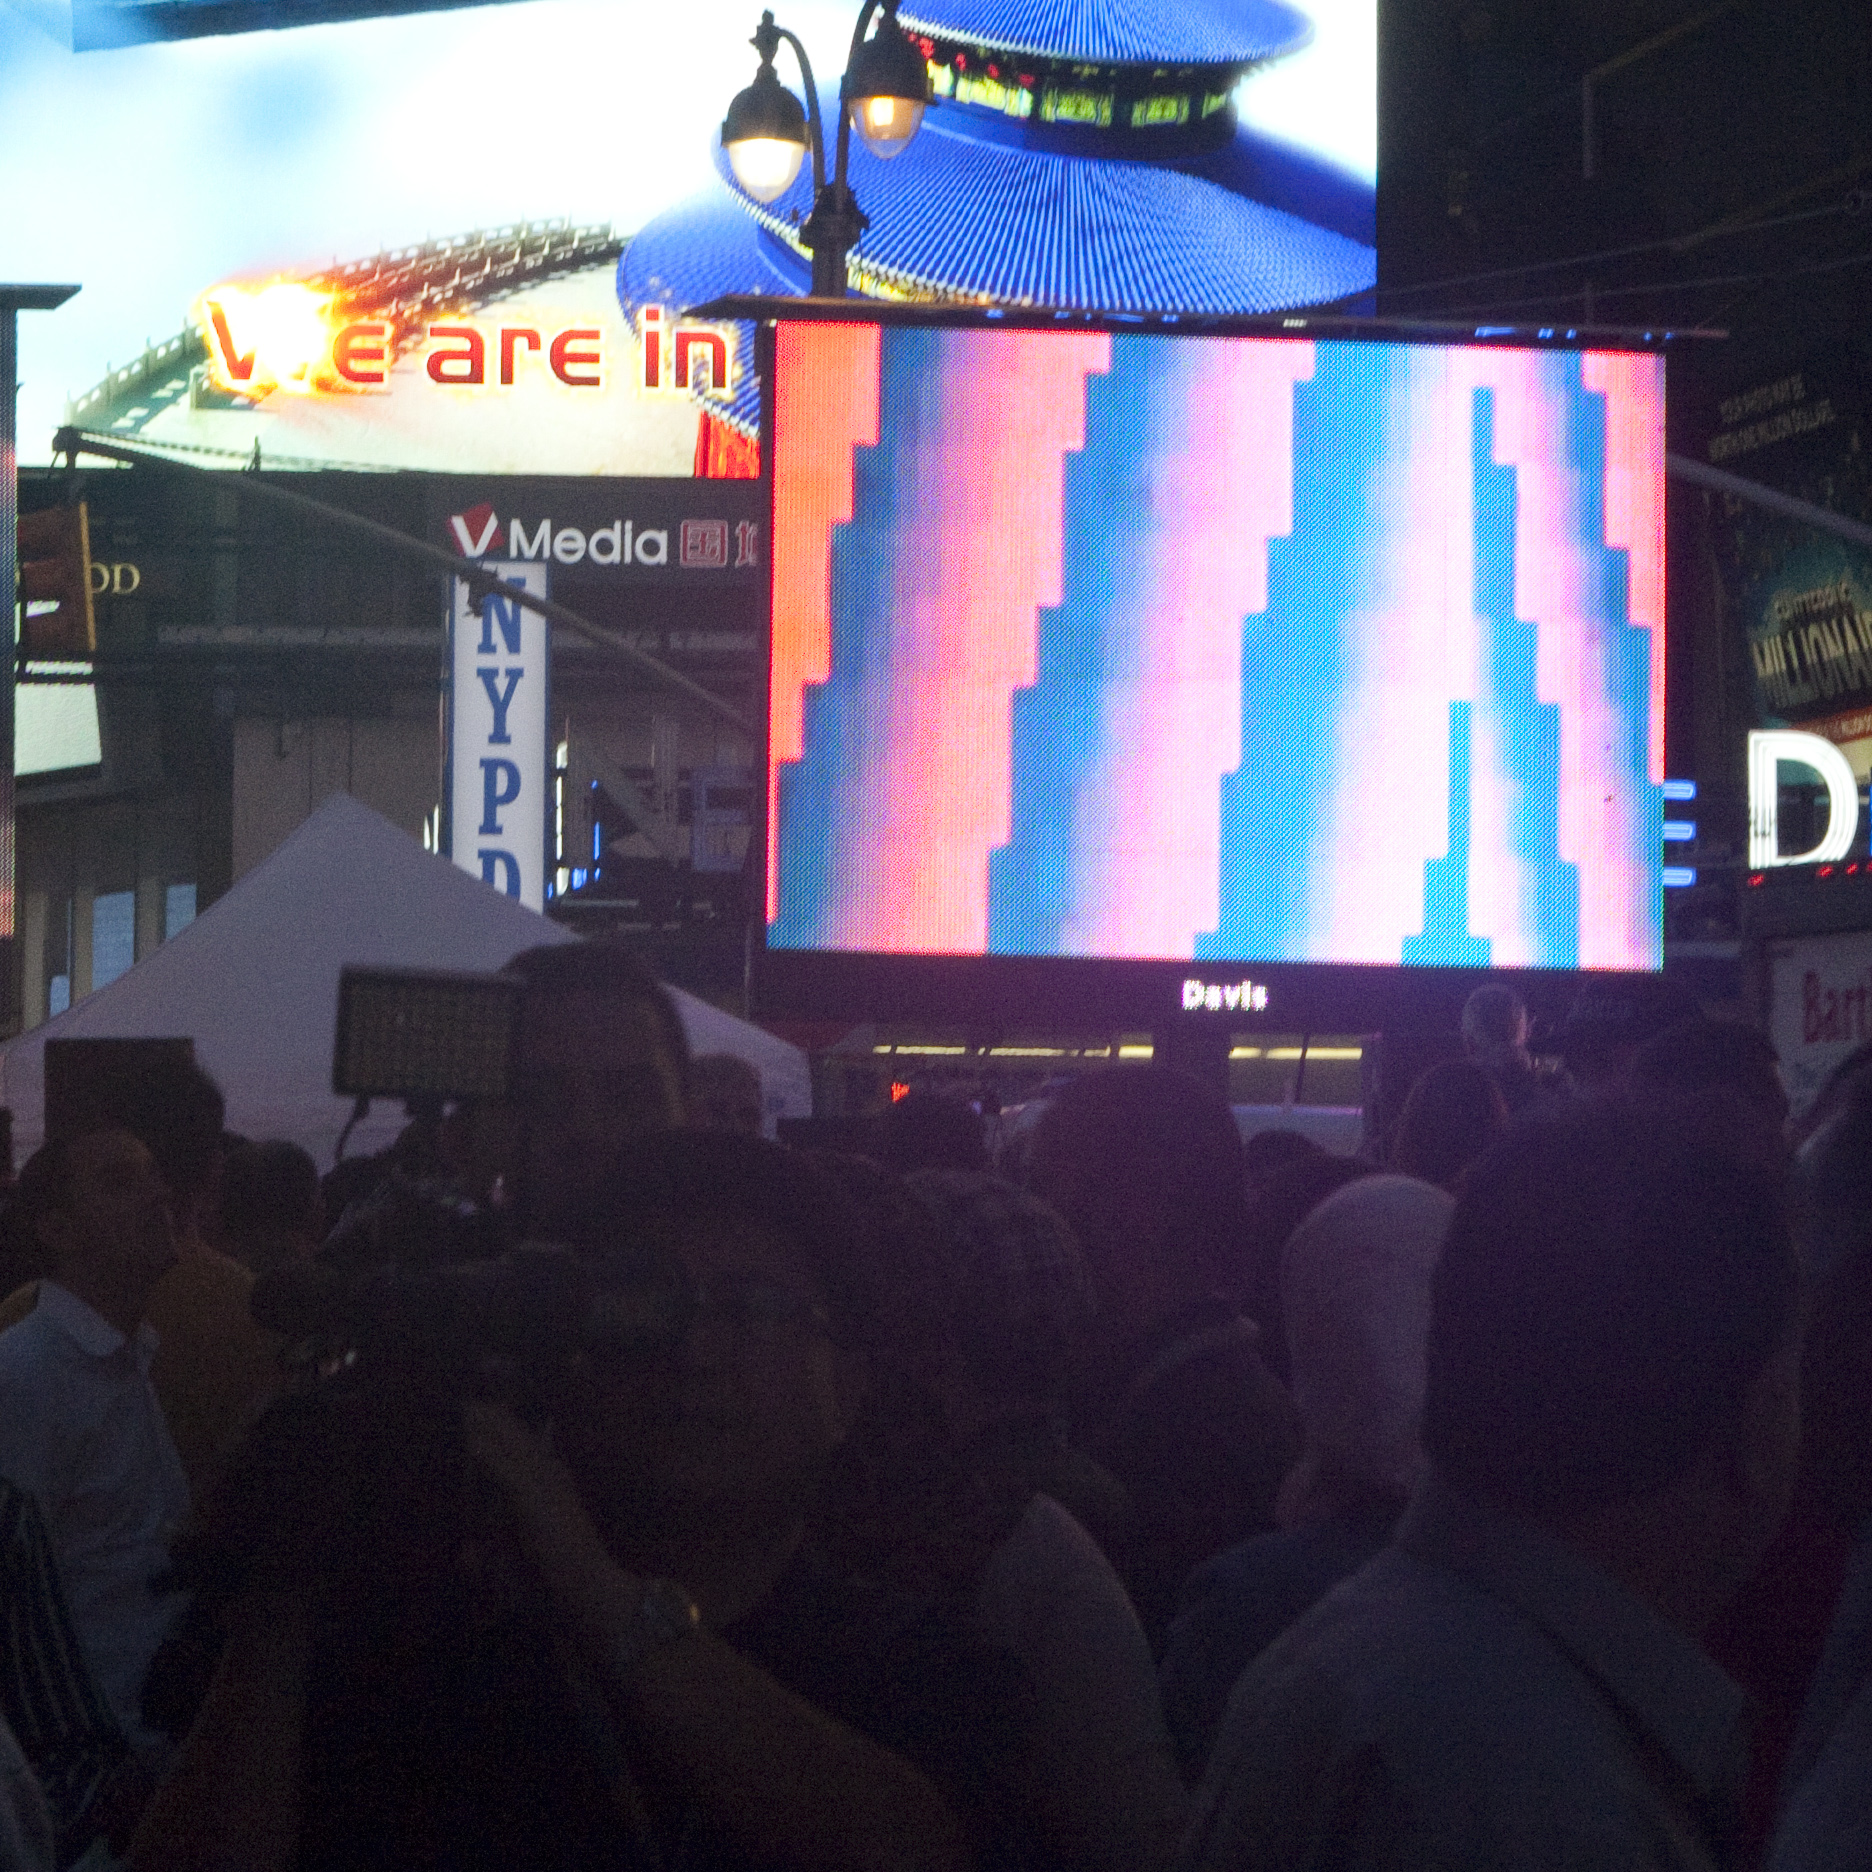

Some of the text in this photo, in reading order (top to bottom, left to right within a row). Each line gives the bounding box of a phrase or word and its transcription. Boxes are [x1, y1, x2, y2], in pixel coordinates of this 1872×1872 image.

[426, 327, 601, 386] are
[643, 307, 728, 390] in
[508, 516, 669, 566] Media
[1181, 979, 1269, 1011] Davis
